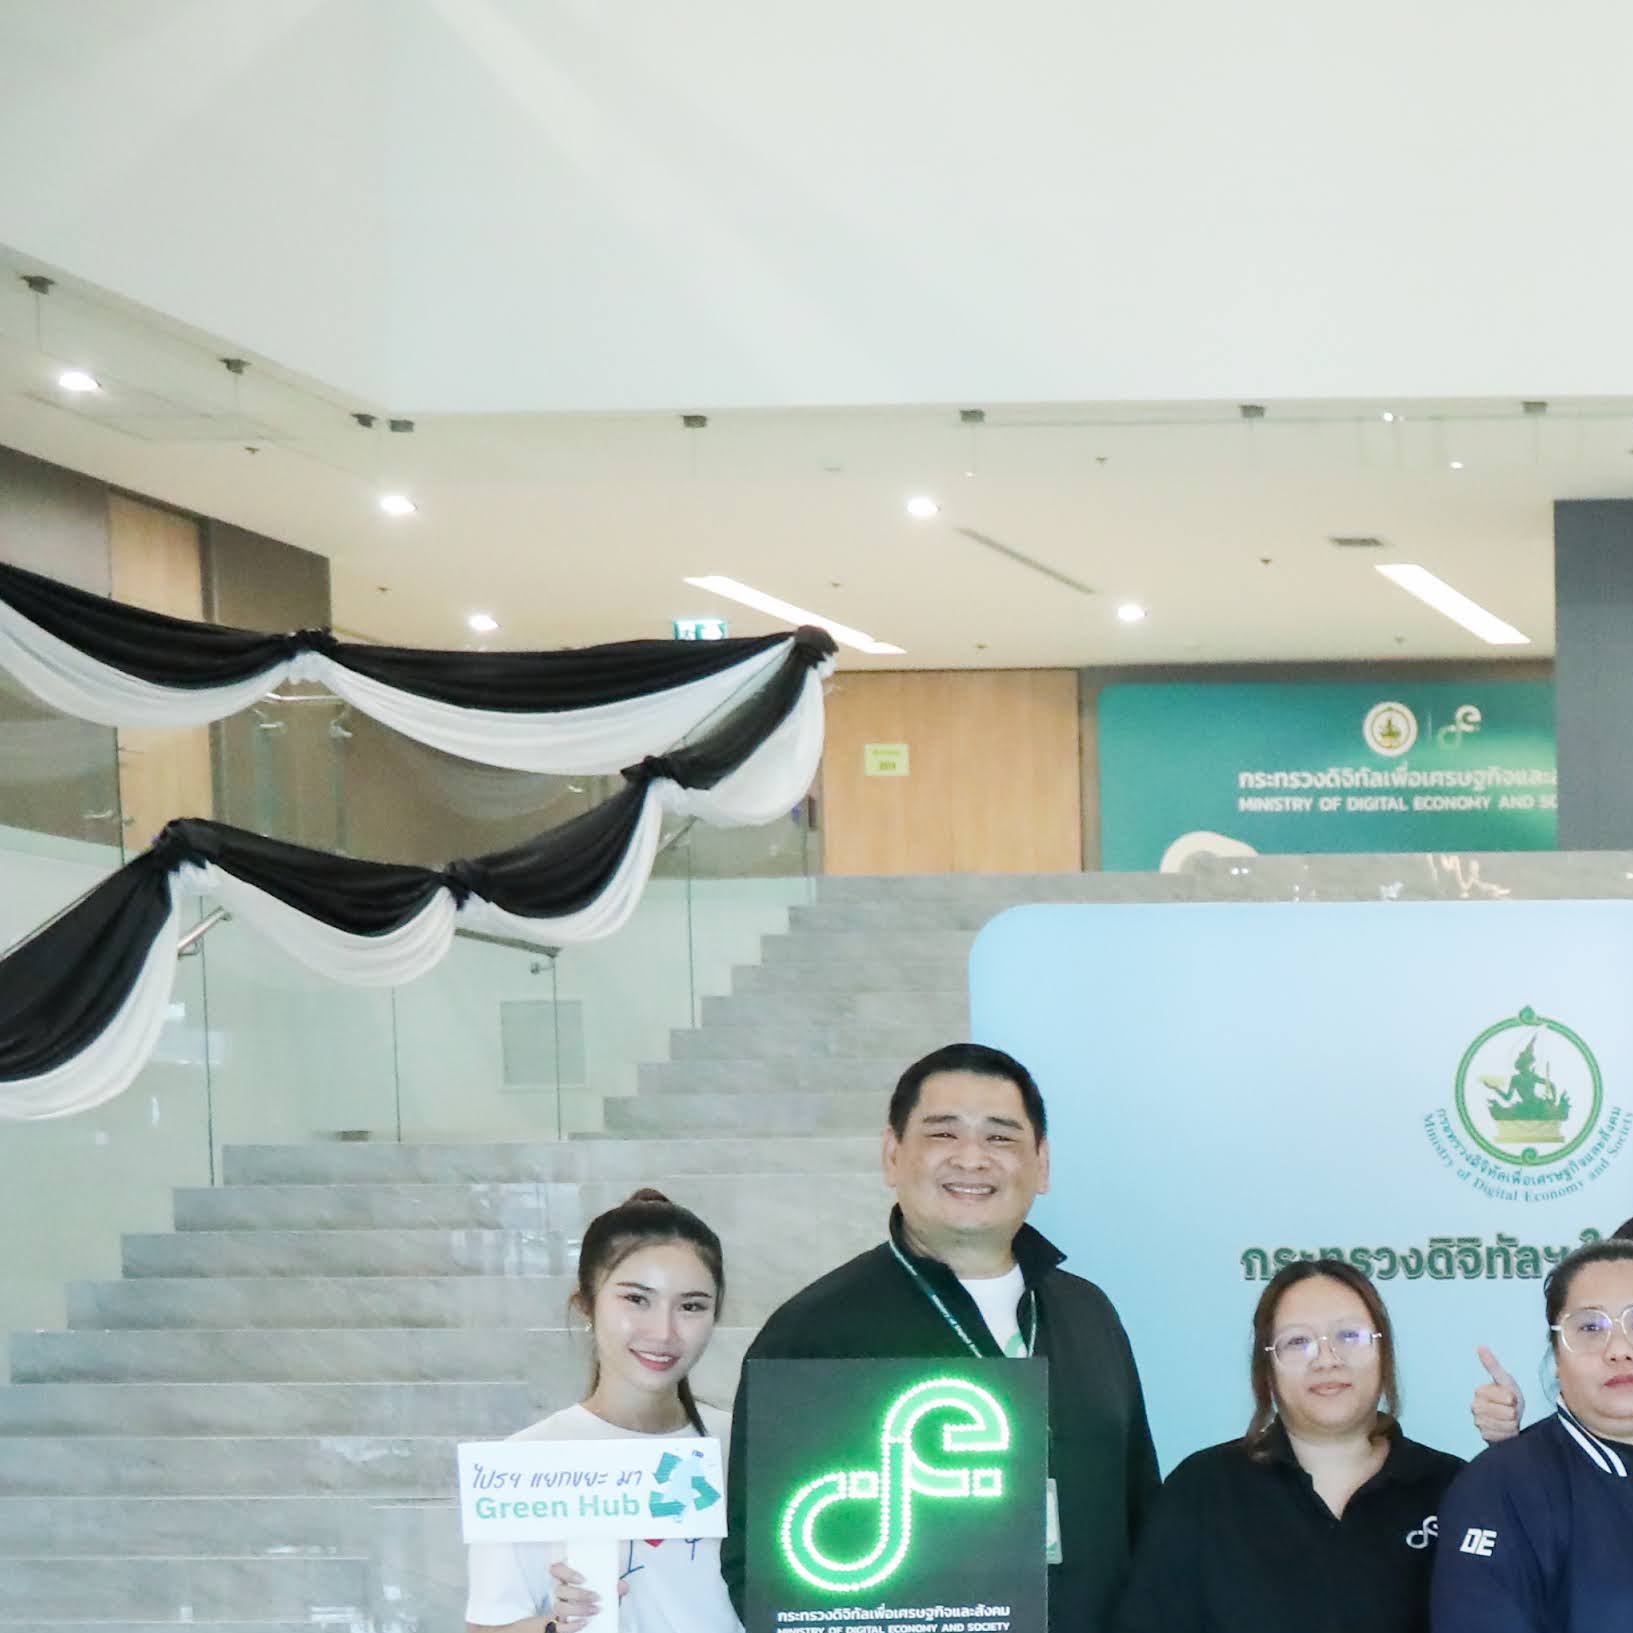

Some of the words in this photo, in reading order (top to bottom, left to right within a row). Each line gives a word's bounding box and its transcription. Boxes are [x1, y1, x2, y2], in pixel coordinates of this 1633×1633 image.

[1239, 763, 1557, 790] กระทรวงดิจิทัลเพื่อเศรษฐกิจและ
[1239, 796, 1312, 812] MINISTRY
[1319, 796, 1342, 812] OF
[1347, 796, 1407, 812] DIGITAL
[1413, 796, 1491, 811] ECONOMY
[1498, 795, 1534, 810] AND
[1423, 1112, 1455, 1168] Ministry
[1456, 1168, 1472, 1182] of
[1472, 1177, 1519, 1202] Digital
[1524, 1180, 1586, 1202] Economy
[1588, 1158, 1610, 1181] and
[475, 1495, 569, 1520] Green
[578, 1491, 641, 1518] Hub
[1459, 1527, 1498, 1557] DE
[777, 1603, 1011, 1623] กระทรวงดิจิทัลเพื่อเศรษฐกิจและสังคม
[941, 1623, 965, 1633] AND
[967, 1621, 1011, 1633] SOCIETY
